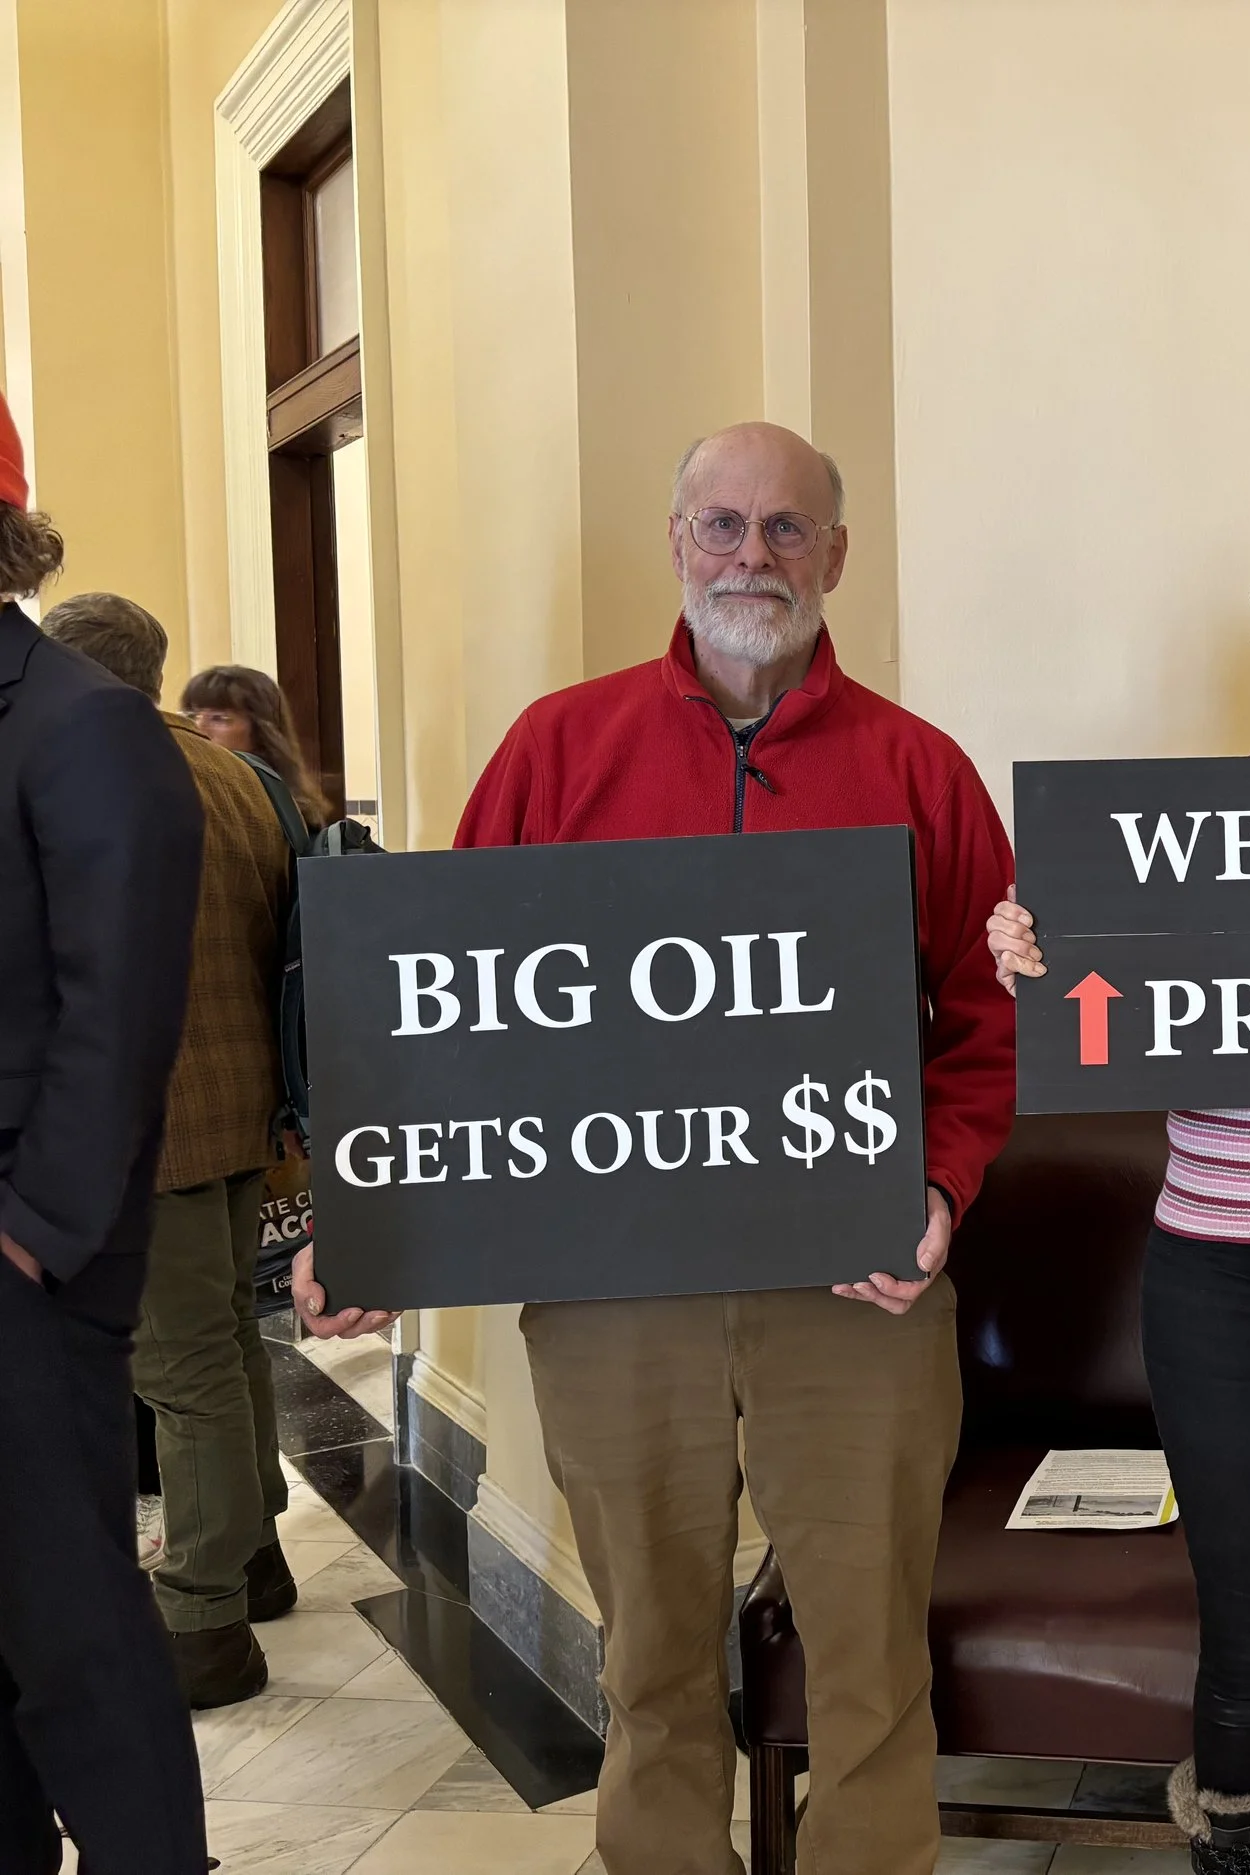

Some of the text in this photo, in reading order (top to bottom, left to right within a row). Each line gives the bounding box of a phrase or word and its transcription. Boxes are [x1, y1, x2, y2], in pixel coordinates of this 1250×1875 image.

[388, 930, 836, 1037] BIG OIL
[334, 1069, 898, 1188] GETS OUR $$
